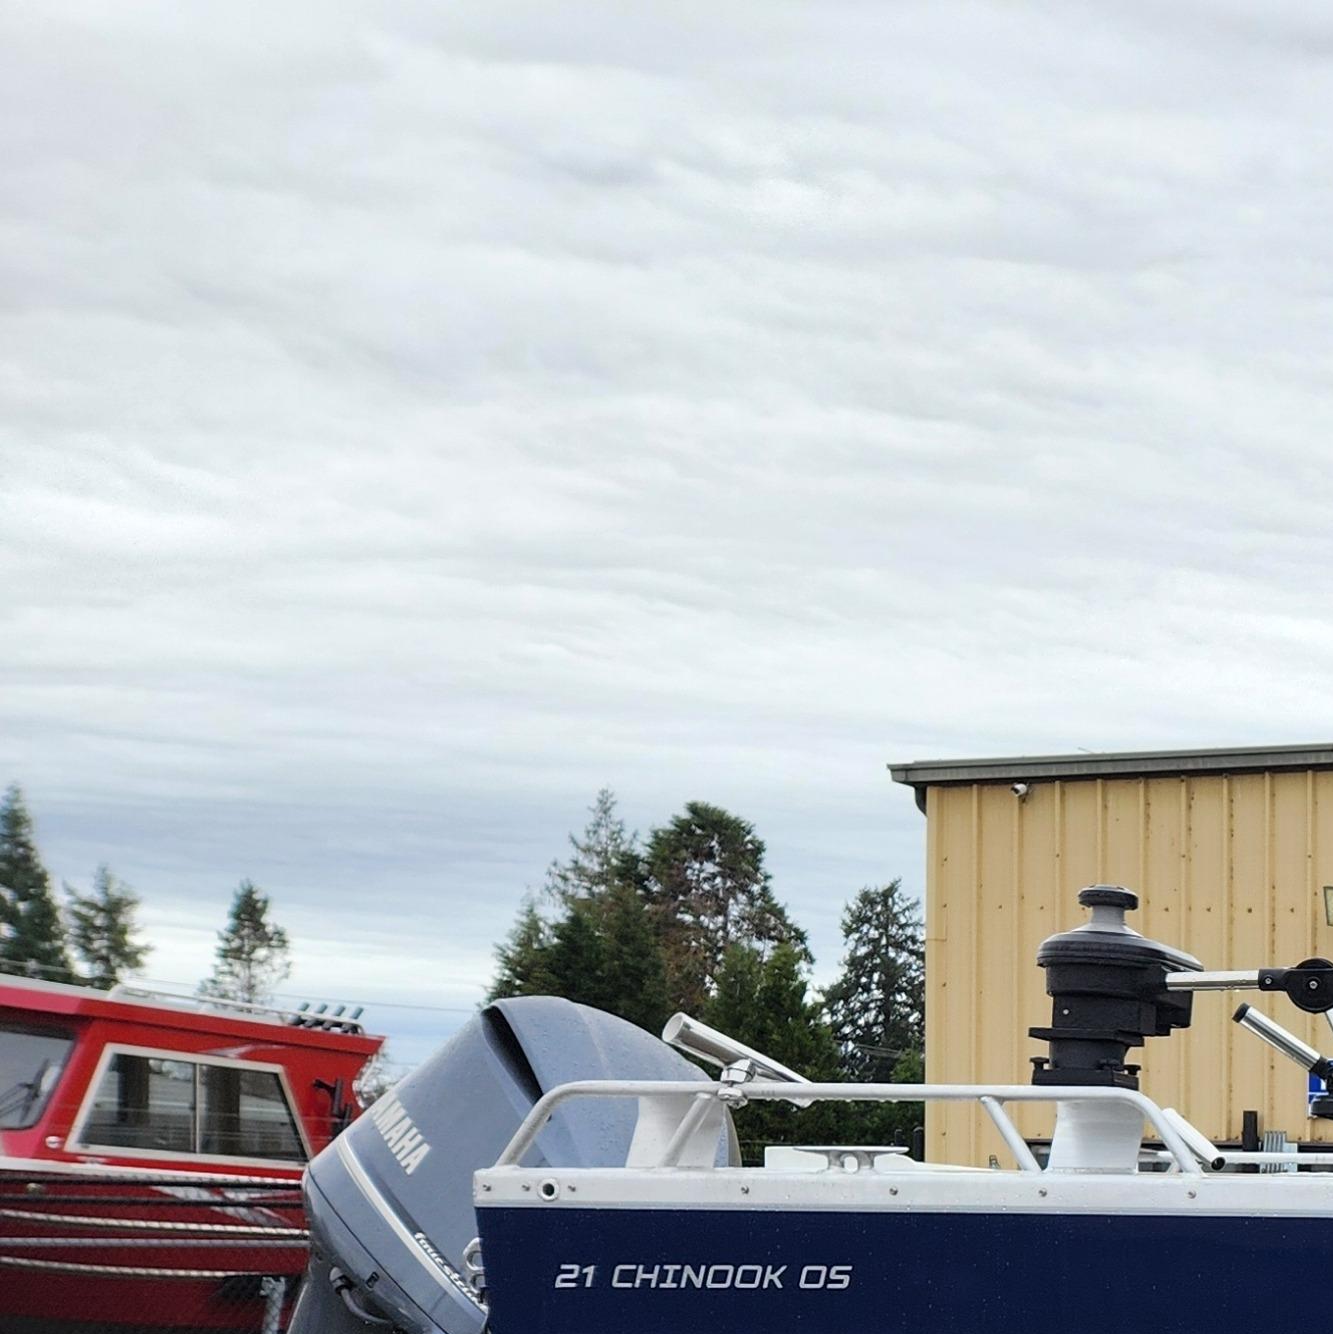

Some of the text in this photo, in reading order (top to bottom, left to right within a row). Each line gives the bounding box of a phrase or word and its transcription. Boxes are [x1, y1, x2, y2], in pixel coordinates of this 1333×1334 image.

[555, 1263, 854, 1290] 21 CHINOOK OS
